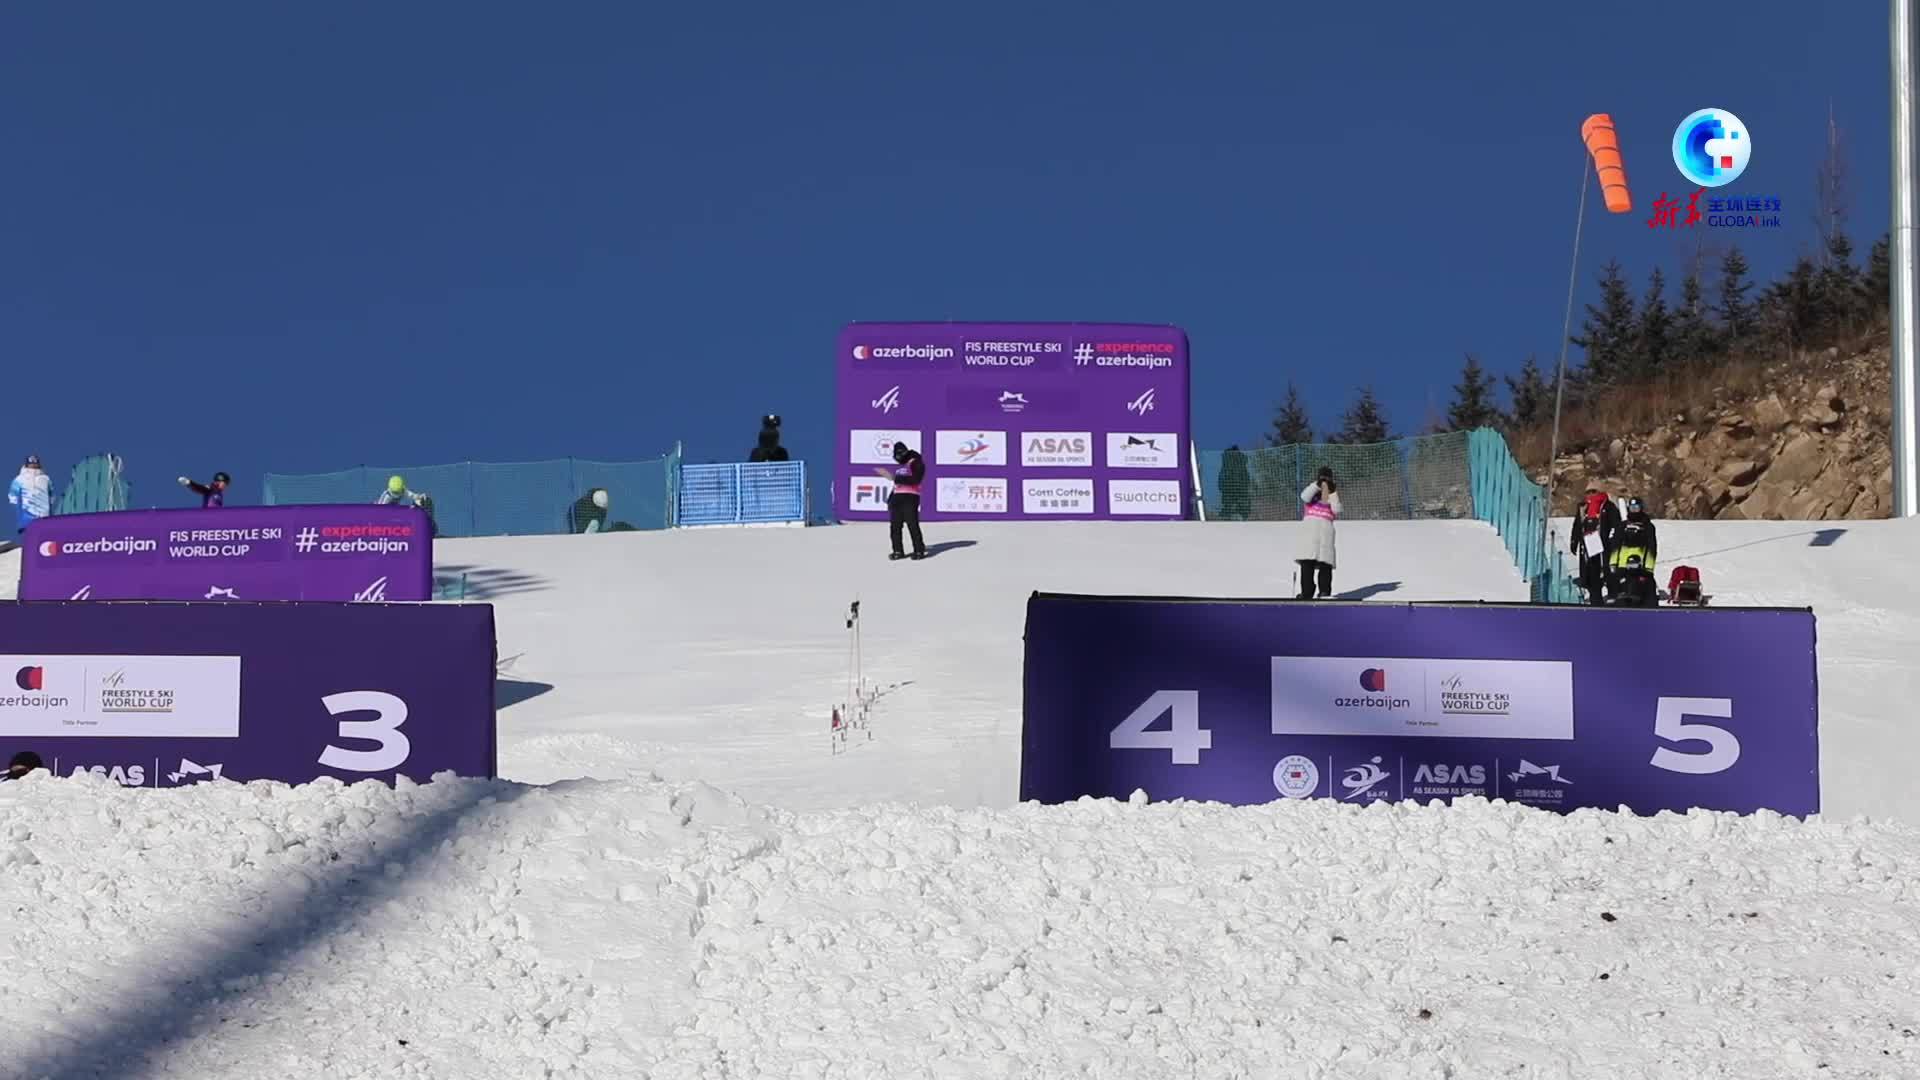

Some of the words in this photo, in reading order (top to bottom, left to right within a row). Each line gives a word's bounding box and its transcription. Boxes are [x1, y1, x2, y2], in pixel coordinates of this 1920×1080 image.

[873, 345, 953, 361] azerbaijan
[965, 342, 981, 352] FIS
[984, 342, 1042, 353] FREESTYLE
[1044, 343, 1062, 352] SKI
[1096, 342, 1174, 354] experience
[965, 355, 1008, 366] WORLD
[1010, 356, 1034, 366] CUP
[1096, 354, 1172, 370] azerbaijan
[1028, 438, 1085, 453] ASAS
[856, 485, 890, 503] FIL
[968, 485, 1003, 500] 京东
[1055, 487, 1090, 497] Coffee
[1114, 491, 1167, 503] swatch
[170, 531, 188, 542] FIS
[192, 528, 258, 541] FREESTYLE
[262, 528, 282, 539] SKI
[322, 525, 412, 538] experience
[62, 536, 156, 555] azerbaijan
[169, 546, 219, 557] WORLD
[222, 545, 249, 556] CUP
[321, 538, 408, 555] azerbaijan
[102, 690, 155, 698] FREESTYLE
[158, 690, 174, 698] SKI
[1441, 692, 1490, 700] FREESTYLE
[1494, 693, 1510, 701] SKI
[102, 698, 147, 708] WORLD
[150, 698, 173, 708] CUP
[1335, 695, 1410, 711] azerbaijan
[1441, 700, 1484, 710] WORLD
[1487, 701, 1511, 711] CUP
[317, 690, 411, 772] 3
[1109, 689, 1212, 765] 4
[1649, 697, 1741, 775] 5
[1413, 764, 1486, 784] ASAS
[1424, 787, 1450, 795] SEASON
